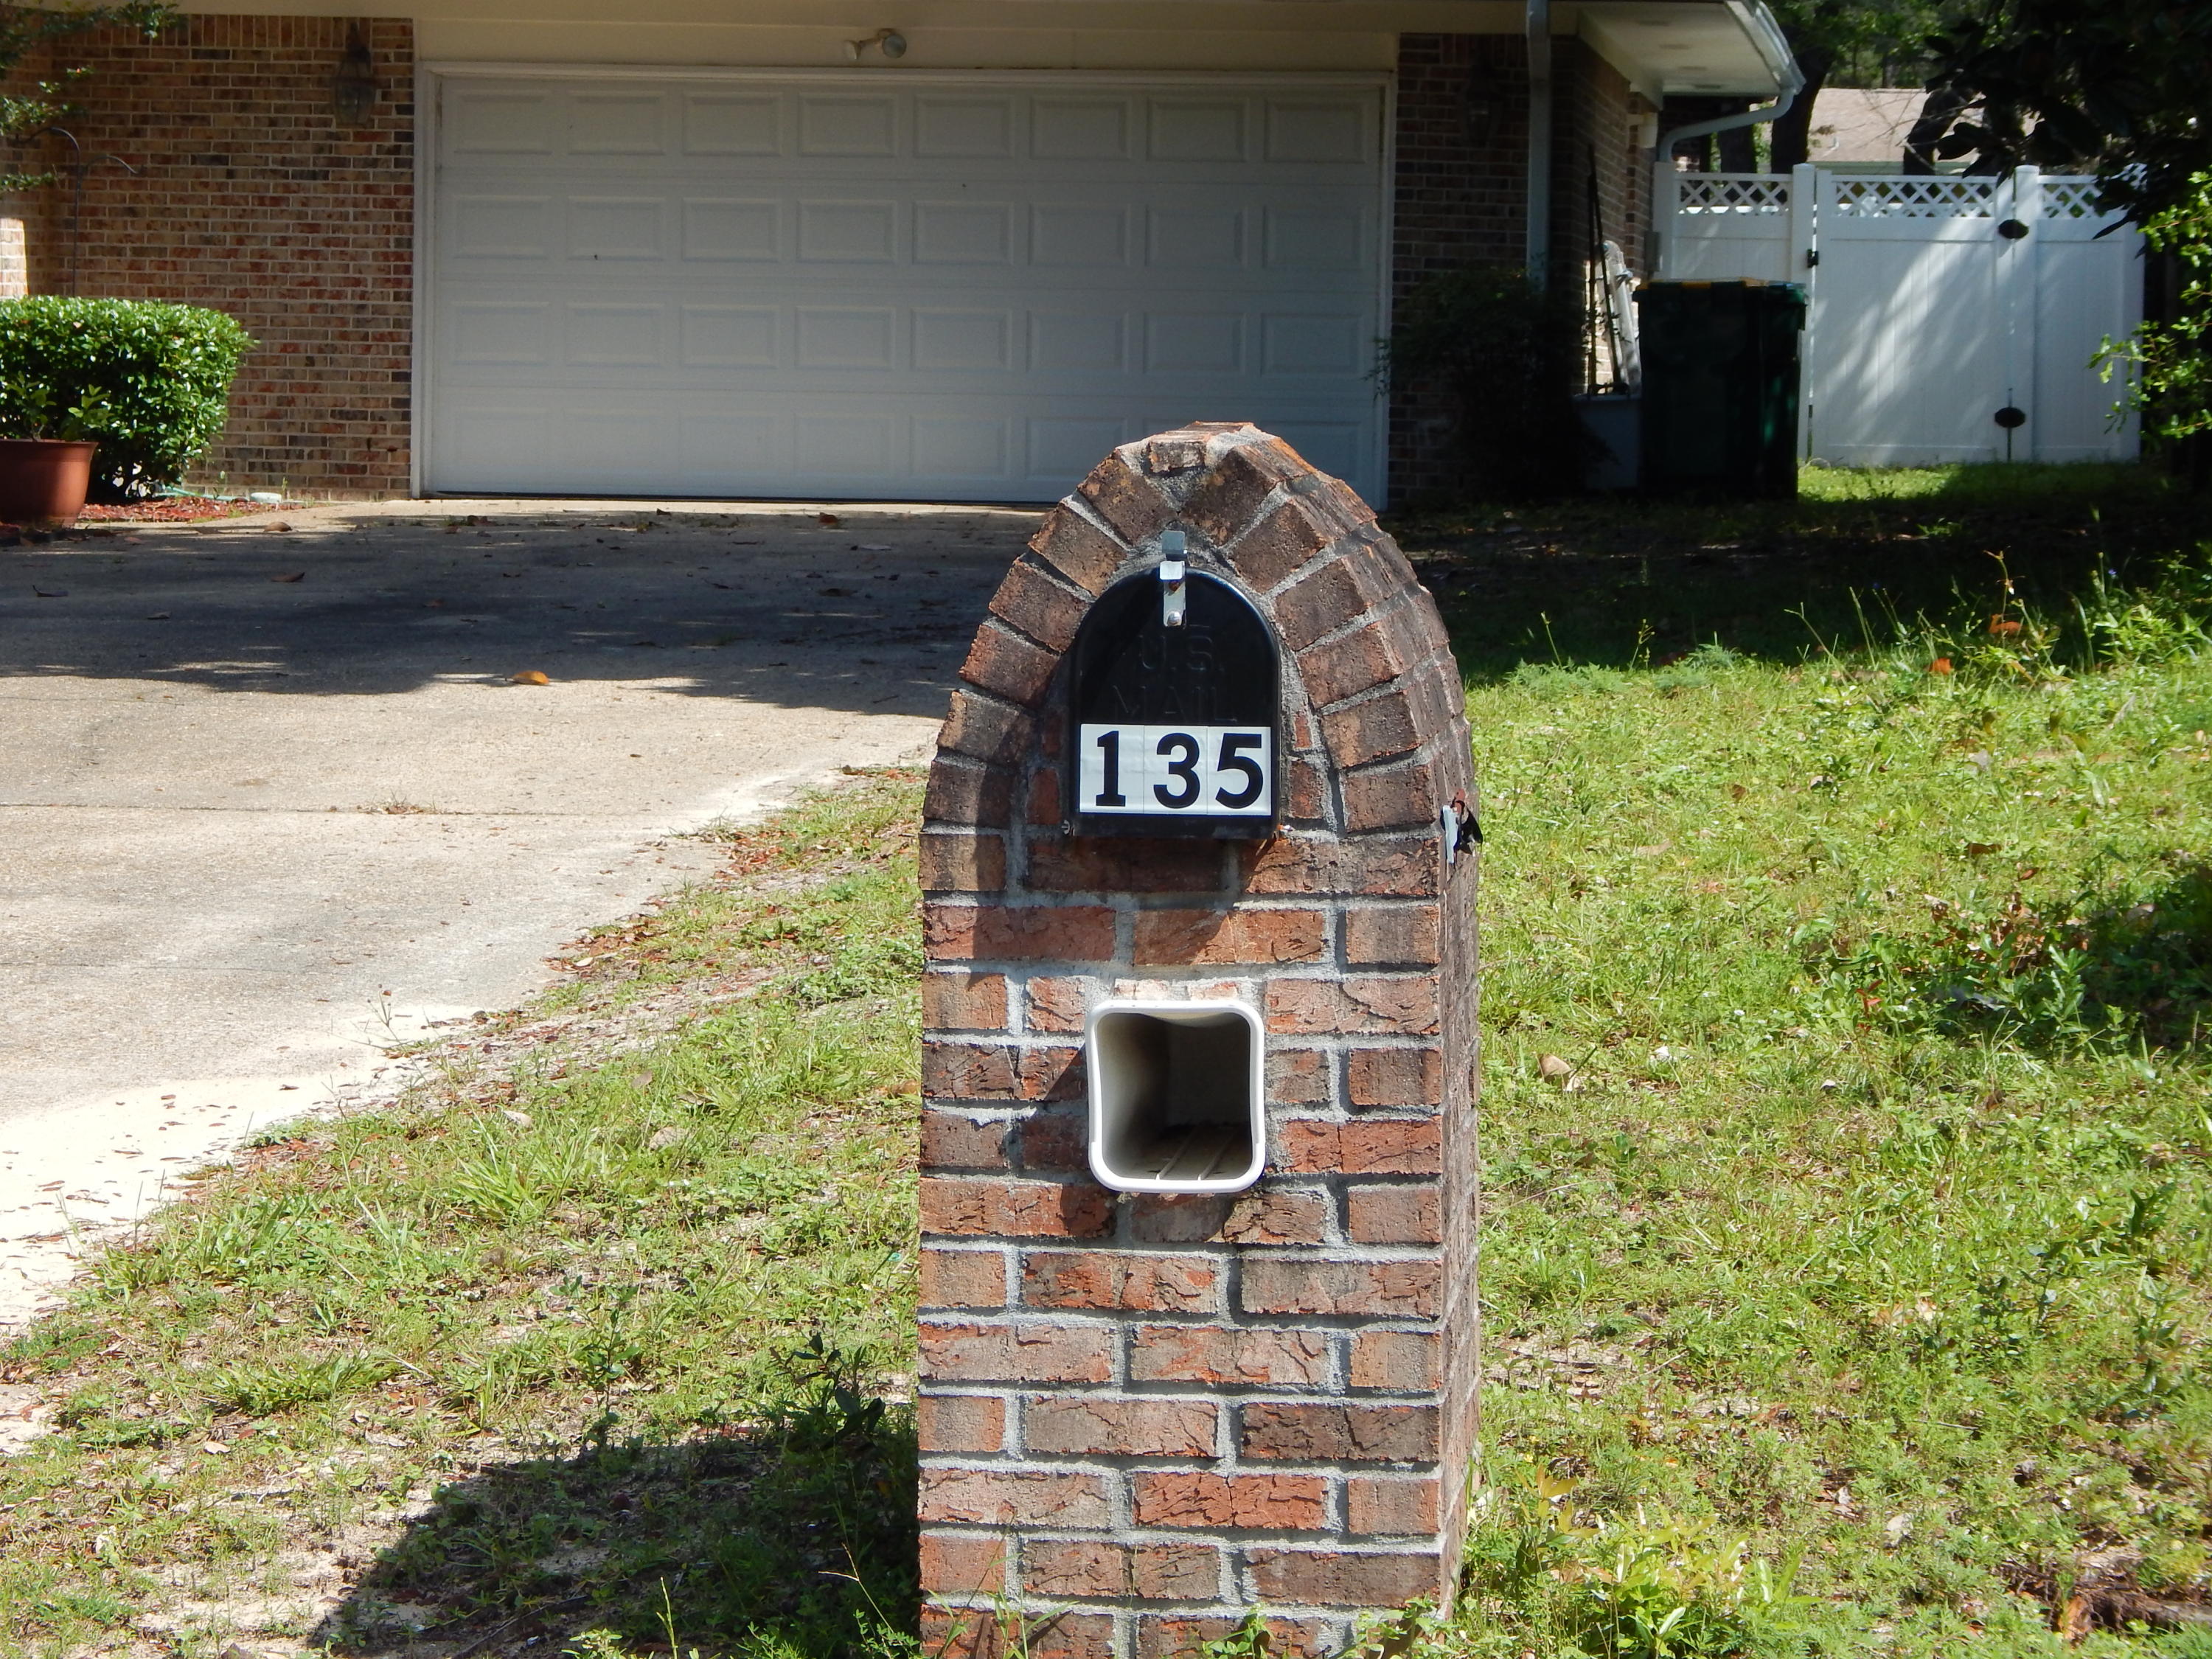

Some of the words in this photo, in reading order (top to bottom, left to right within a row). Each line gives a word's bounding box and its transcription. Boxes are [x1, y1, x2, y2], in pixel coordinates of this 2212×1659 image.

[1137, 633, 1225, 672] U.S.
[1111, 685, 1239, 723] MAIL
[1095, 730, 1264, 809] 135
